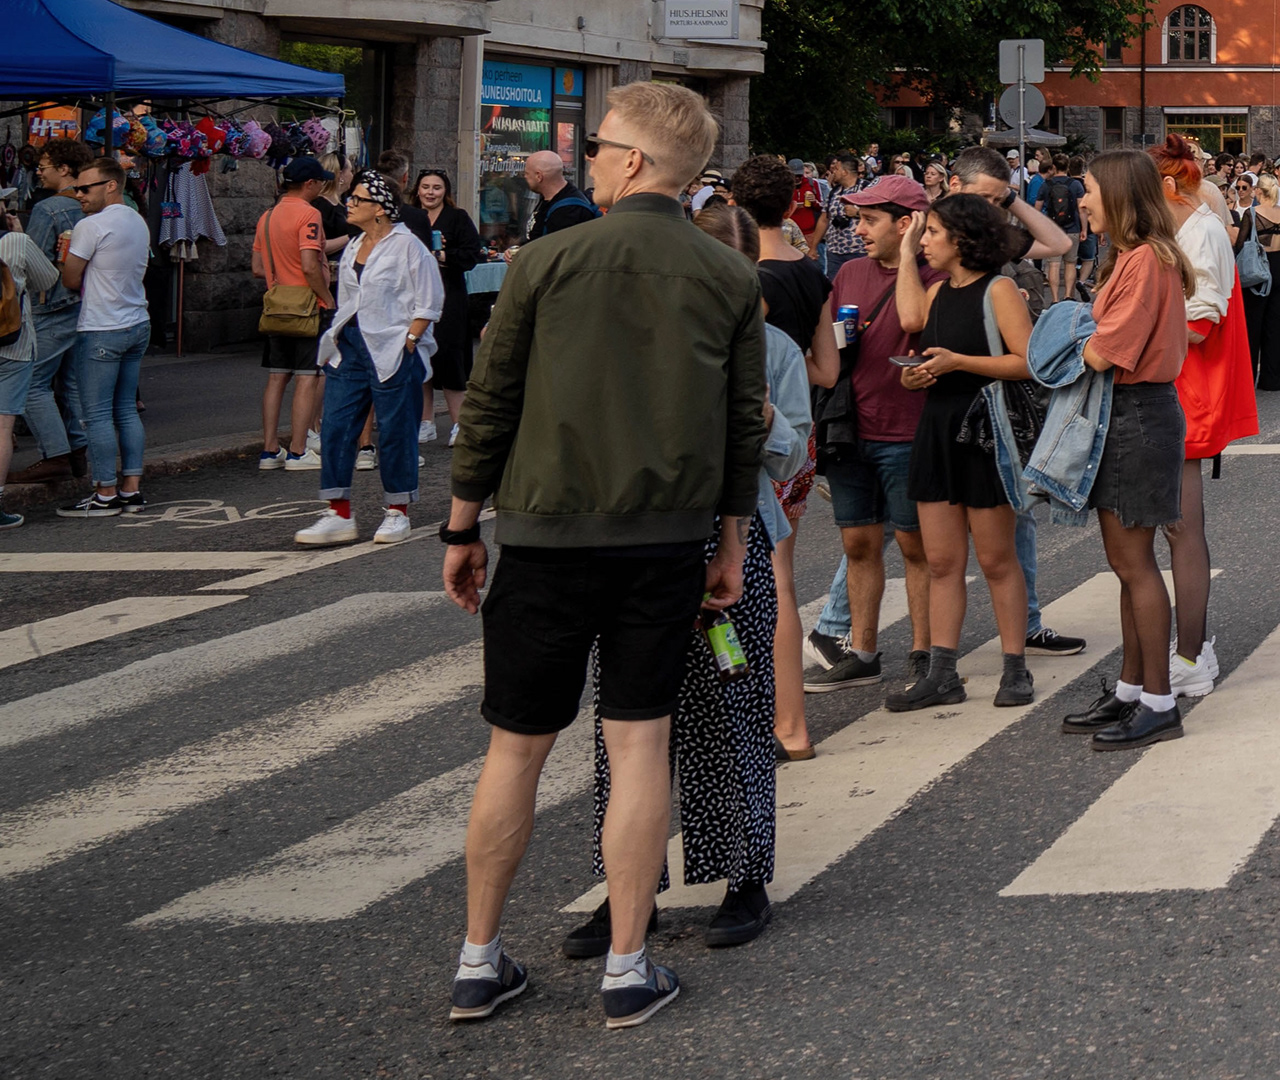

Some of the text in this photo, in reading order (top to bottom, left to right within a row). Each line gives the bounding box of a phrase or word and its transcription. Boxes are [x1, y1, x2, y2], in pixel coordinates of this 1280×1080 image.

[669, 9, 728, 18] HIUS.HELSINKI
[494, 69, 523, 82] perheen
[306, 222, 319, 240] 3
